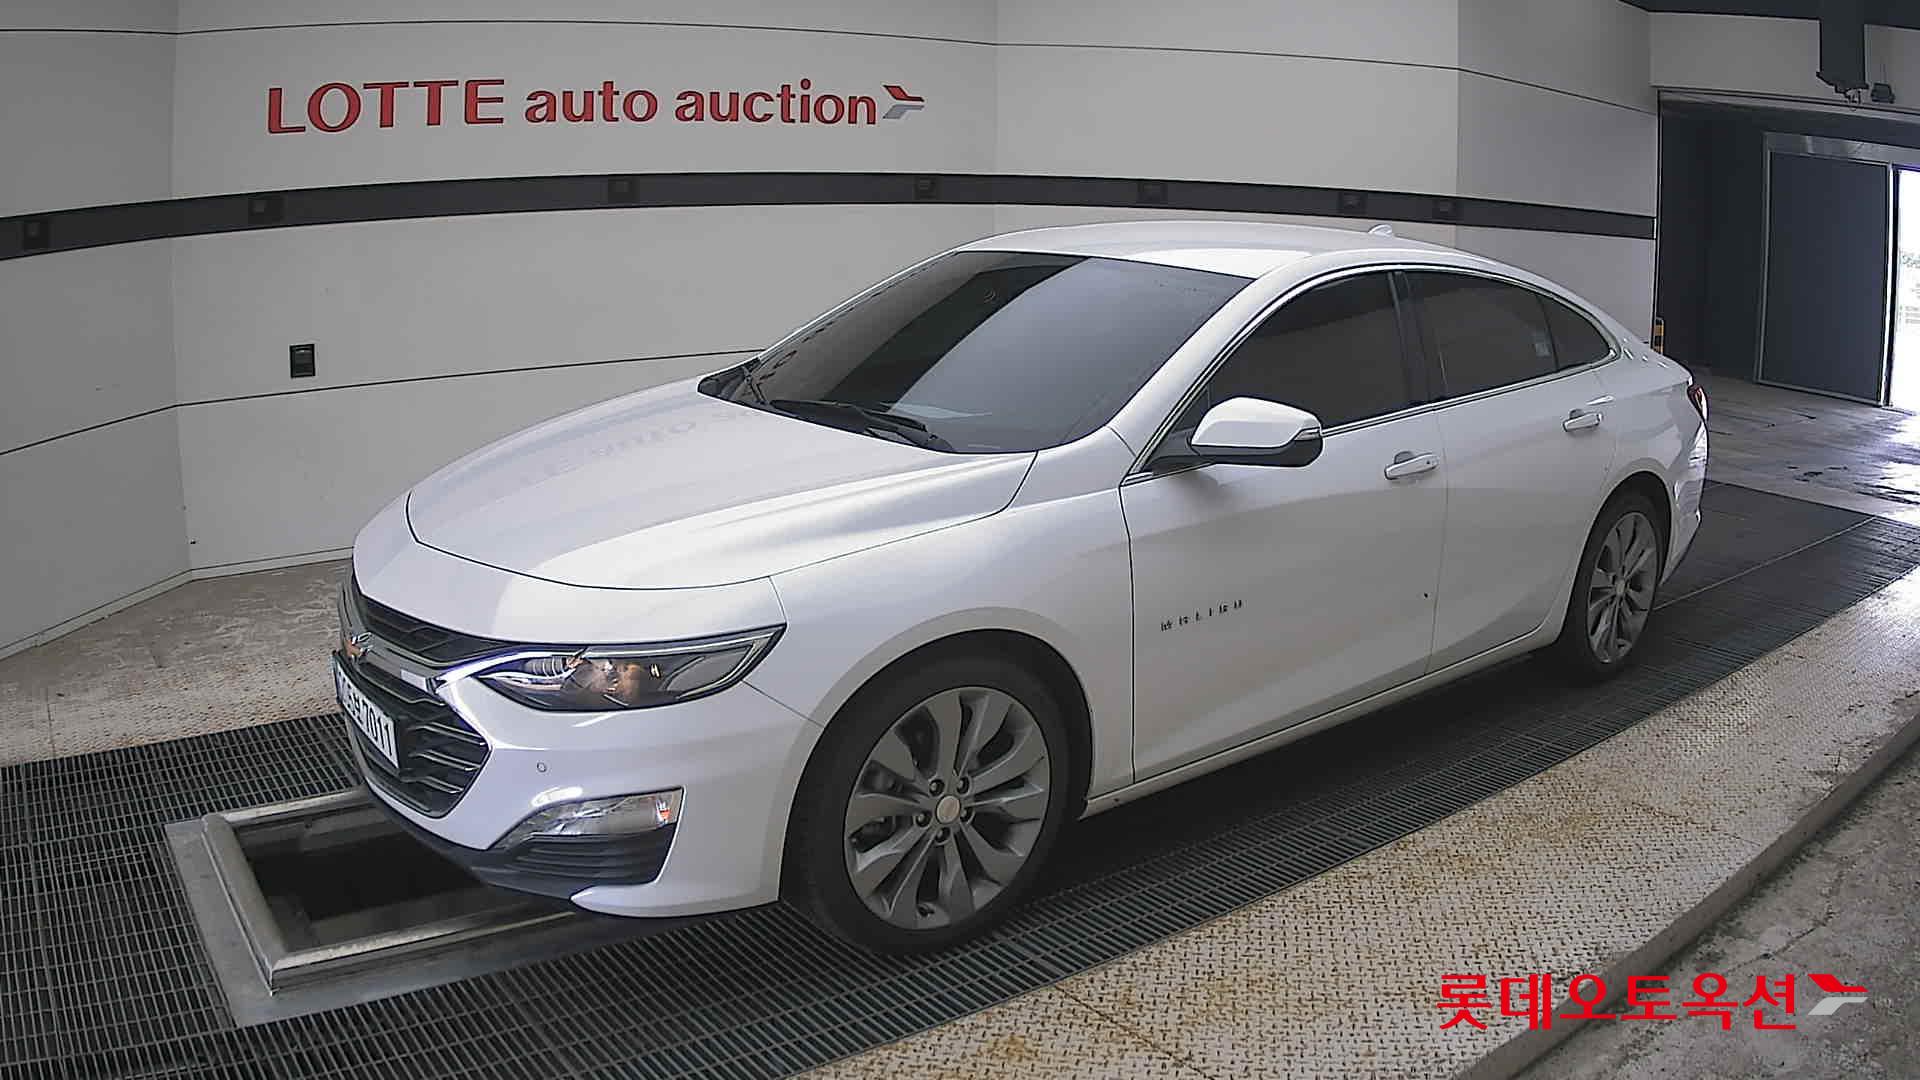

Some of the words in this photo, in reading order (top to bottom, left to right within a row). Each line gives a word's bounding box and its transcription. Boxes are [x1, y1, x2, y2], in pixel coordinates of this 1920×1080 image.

[267, 79, 504, 134] LOTTE
[525, 81, 658, 124] auto
[675, 78, 877, 125] auction
